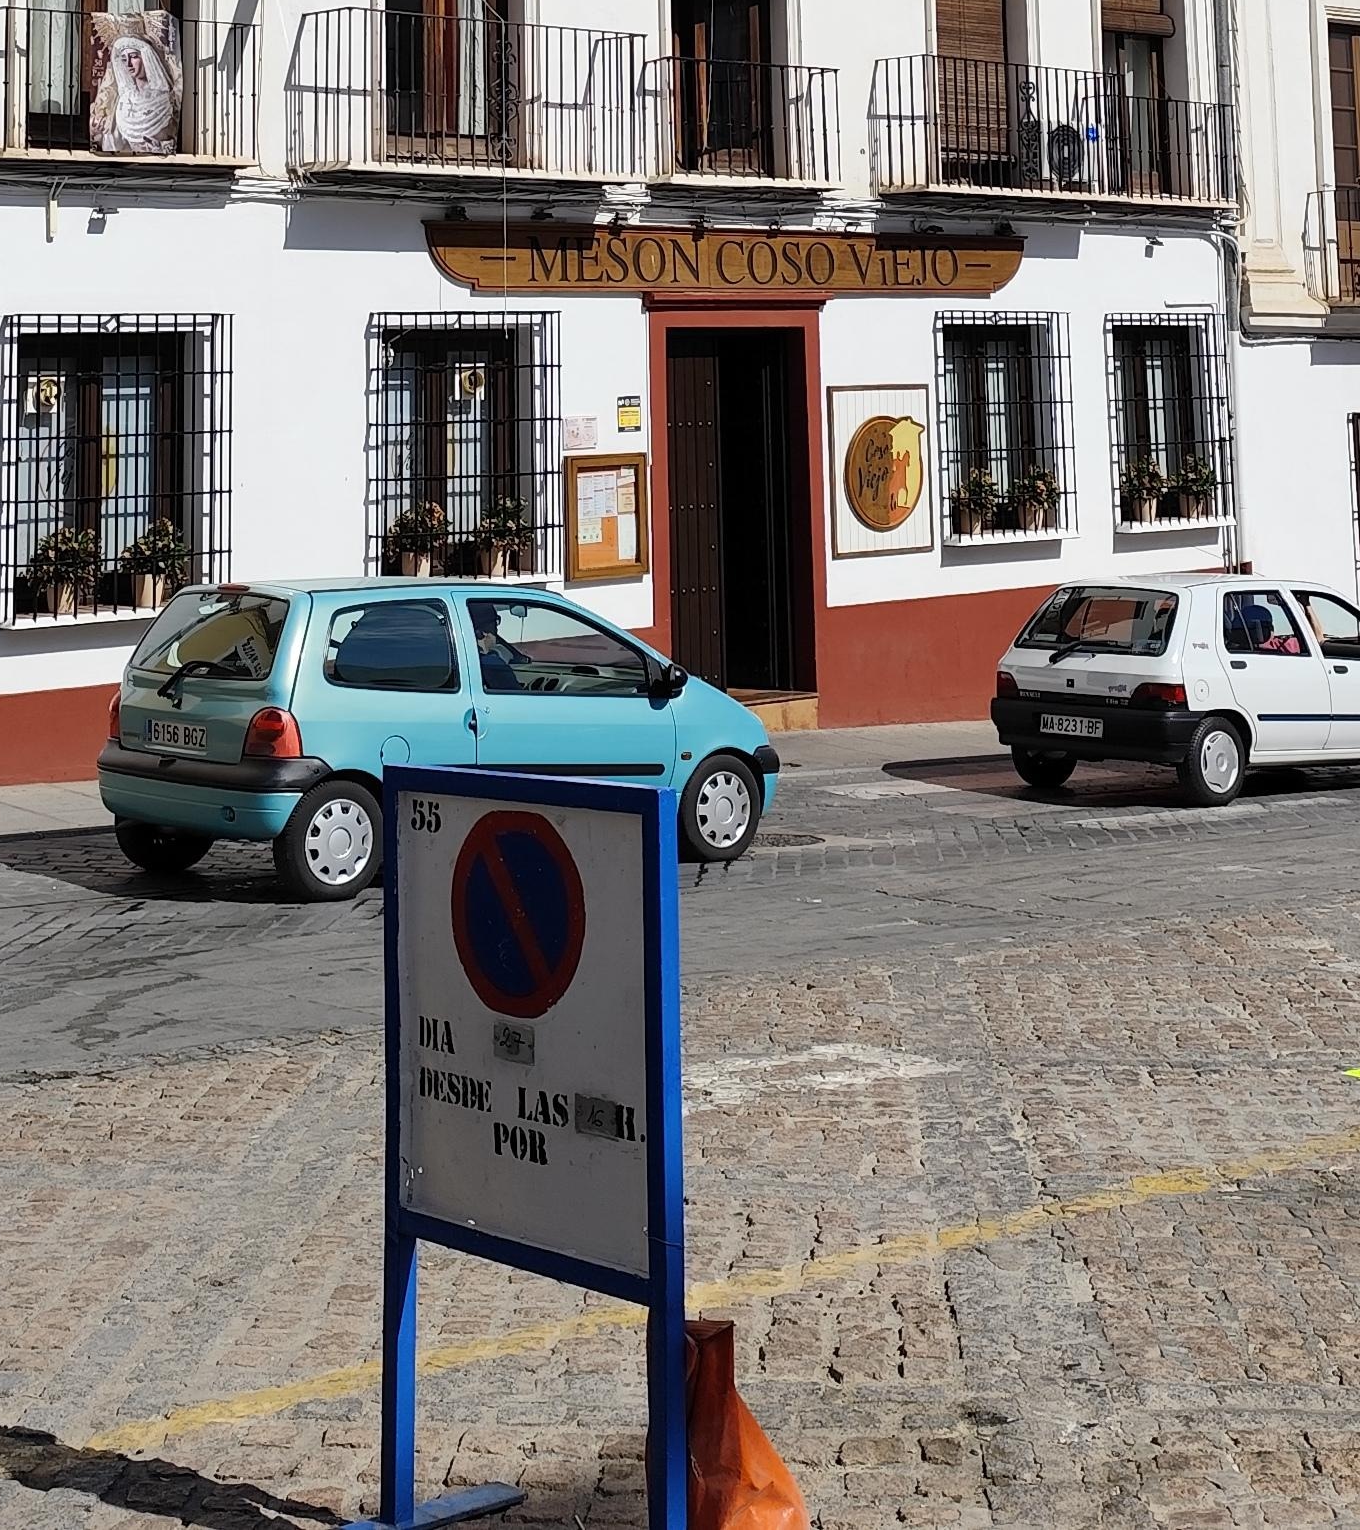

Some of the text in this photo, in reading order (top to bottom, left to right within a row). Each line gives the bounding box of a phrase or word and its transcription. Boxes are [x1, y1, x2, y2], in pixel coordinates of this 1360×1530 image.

[715, 239, 836, 286] COSO
[153, 722, 206, 748] 6156 BGZ
[411, 798, 442, 834] 55
[418, 1015, 456, 1055] DIA
[418, 1066, 493, 1113] DESDE
[517, 1085, 569, 1128] LAS
[492, 1121, 548, 1166] POR
